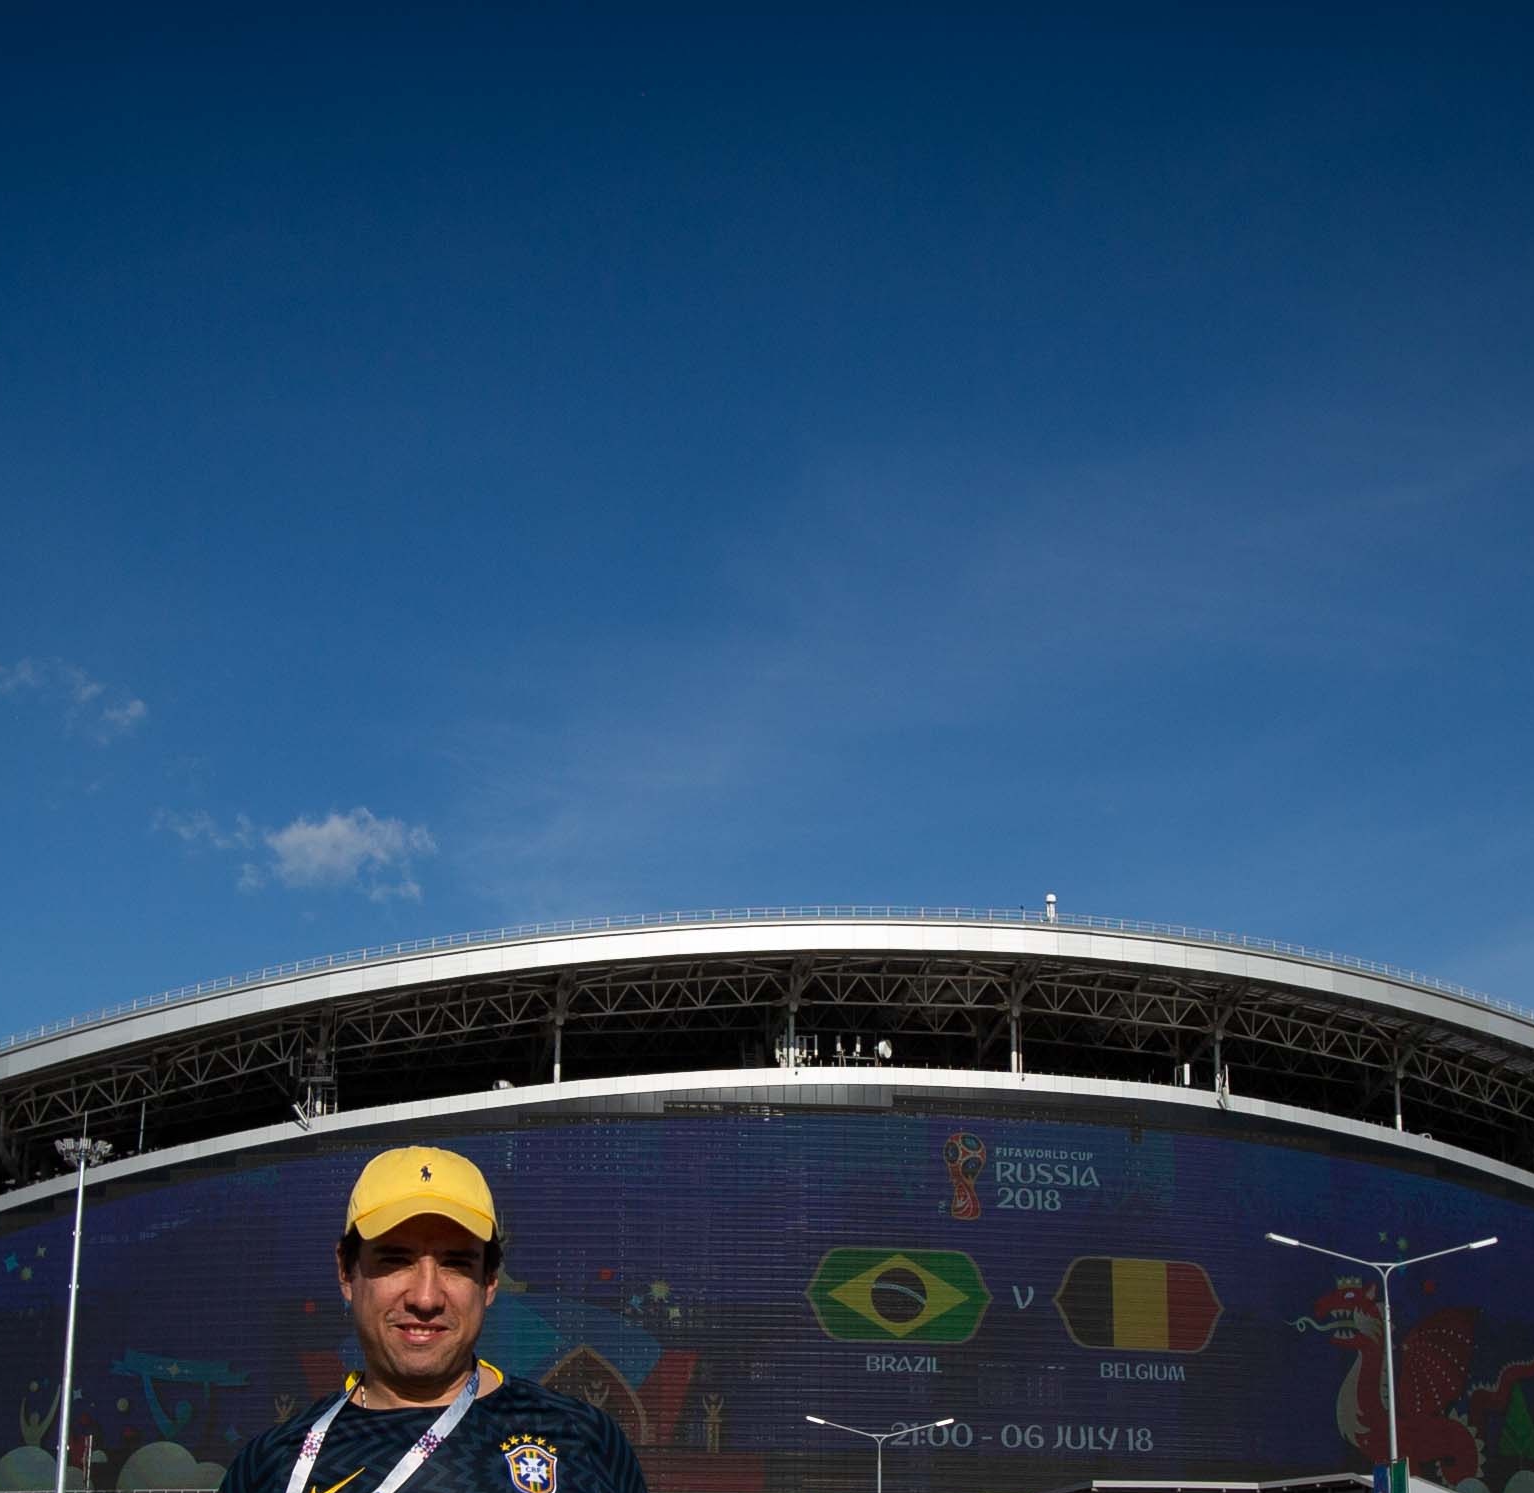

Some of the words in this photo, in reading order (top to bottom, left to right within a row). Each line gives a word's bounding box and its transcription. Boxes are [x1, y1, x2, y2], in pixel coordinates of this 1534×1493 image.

[996, 1147, 1022, 1158] FIFA
[1023, 1149, 1068, 1160] WORLD
[1070, 1151, 1094, 1161] CUP
[996, 1161, 1101, 1187] RUSSIA
[996, 1187, 1062, 1211] 2018
[866, 1355, 943, 1374] BRAZIL
[1100, 1362, 1186, 1382] BELGIUM
[890, 1422, 974, 1448] 21:00
[1000, 1424, 1045, 1450] 06
[1052, 1424, 1120, 1451] JULY
[1126, 1426, 1154, 1452] 18
